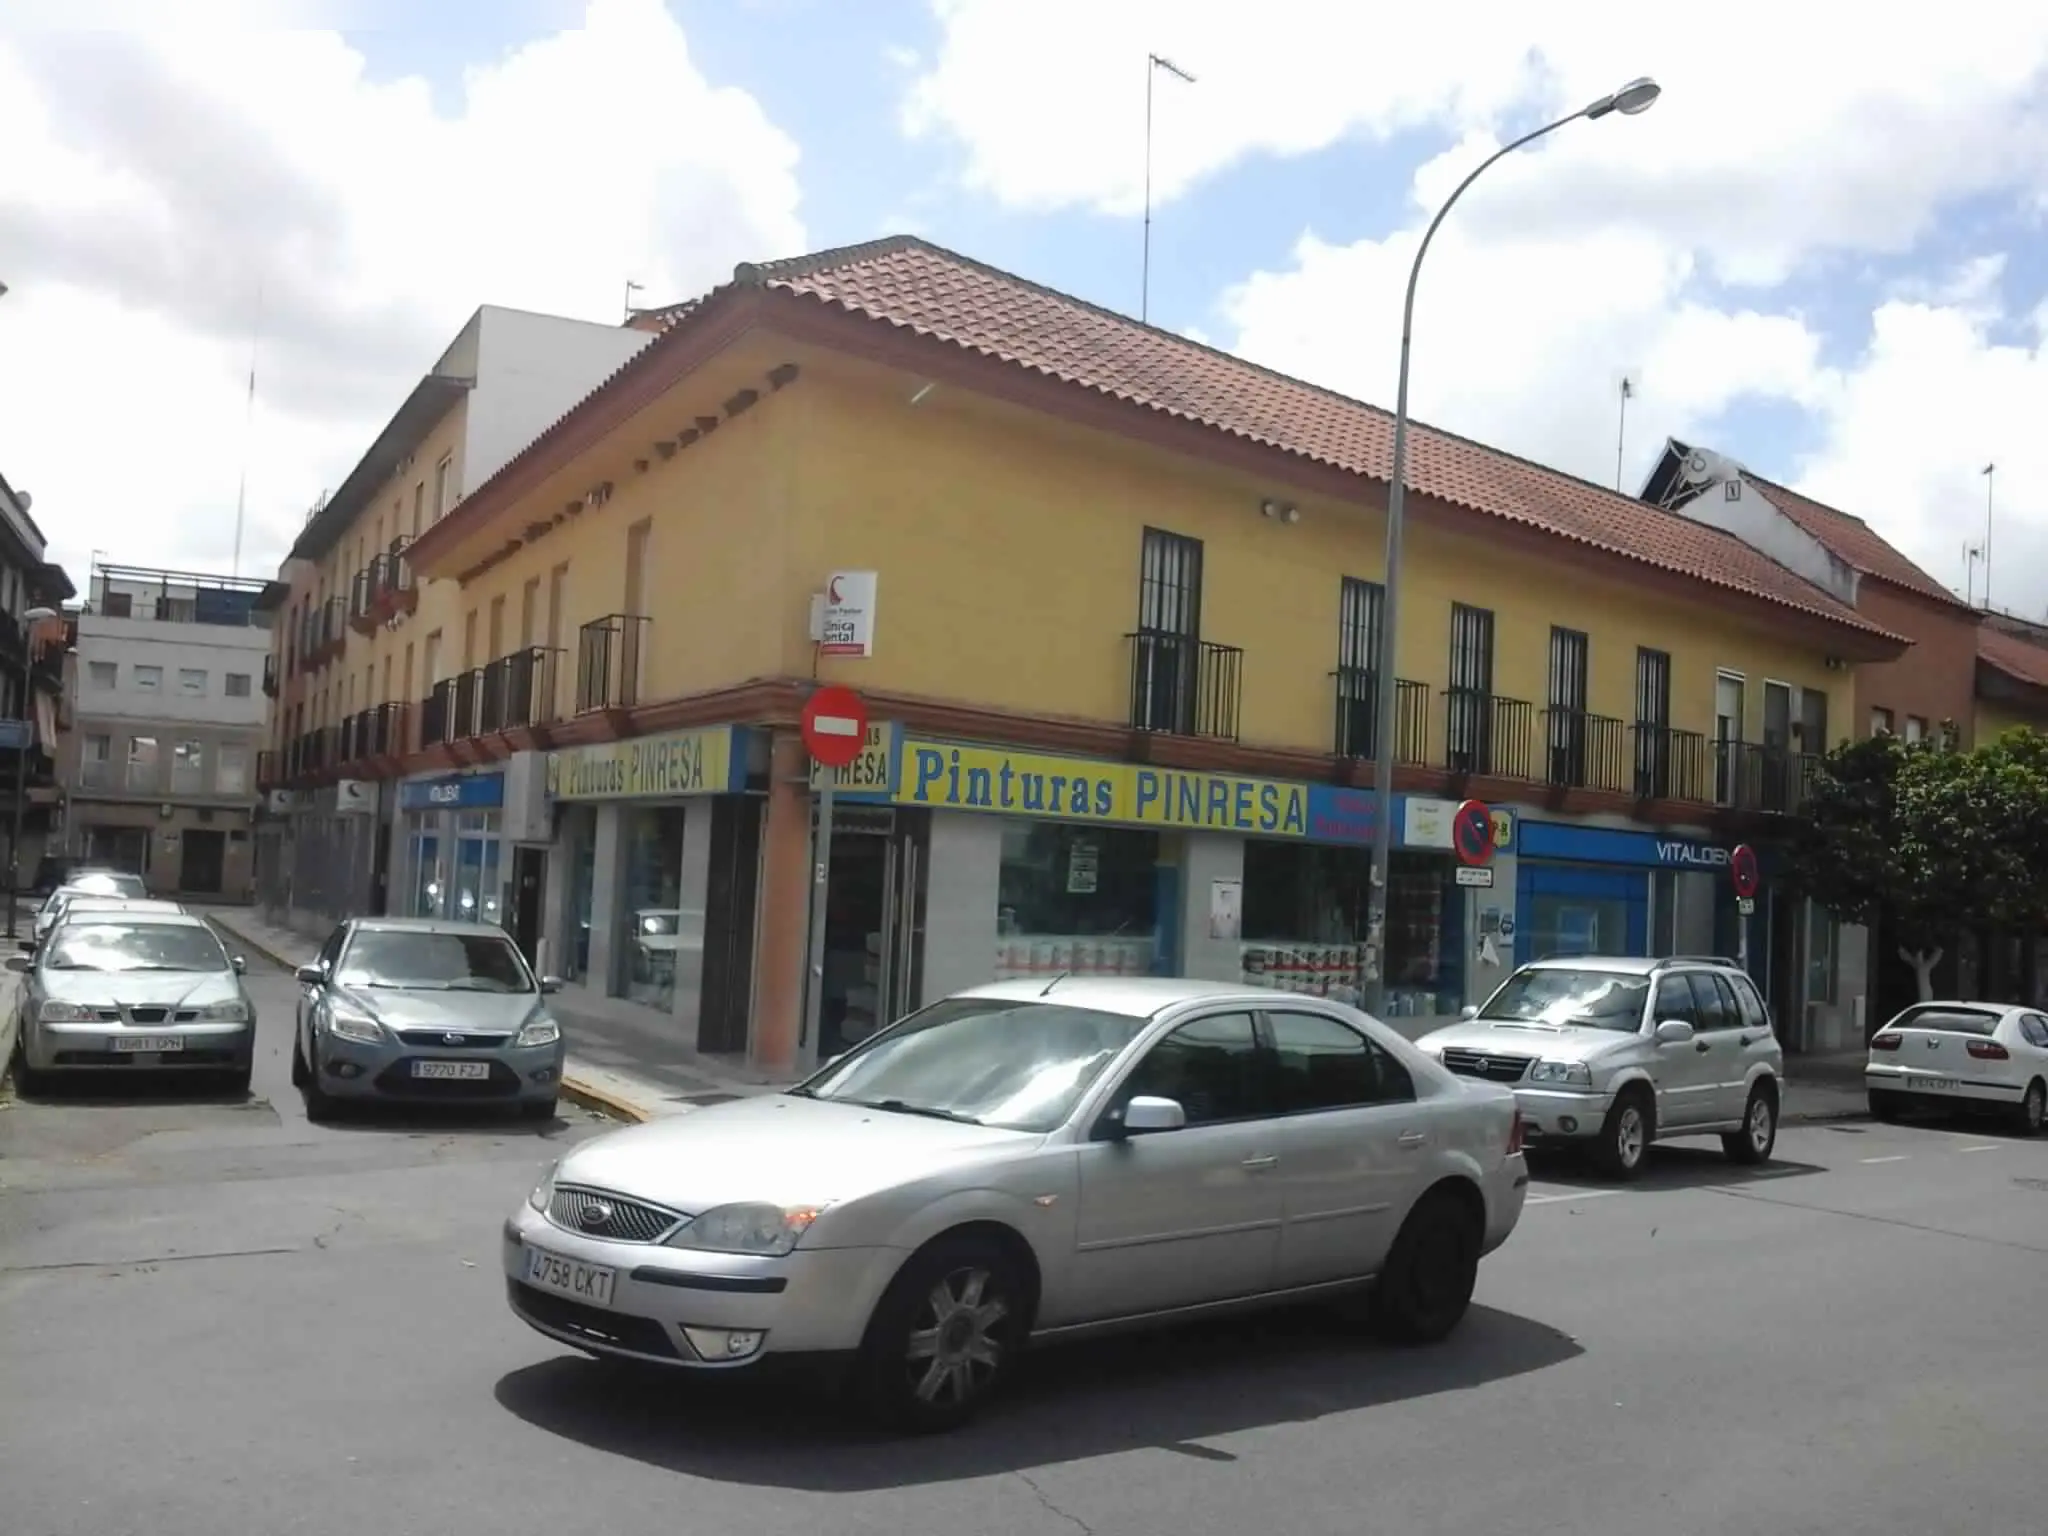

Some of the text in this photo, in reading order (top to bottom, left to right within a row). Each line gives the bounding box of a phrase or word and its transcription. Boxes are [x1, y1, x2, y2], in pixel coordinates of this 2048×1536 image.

[630, 733, 704, 792] PINRESA
[913, 748, 1113, 816] Pinturas
[1136, 770, 1304, 833] PINRESA
[533, 1255, 609, 1299] 4758 CKT
